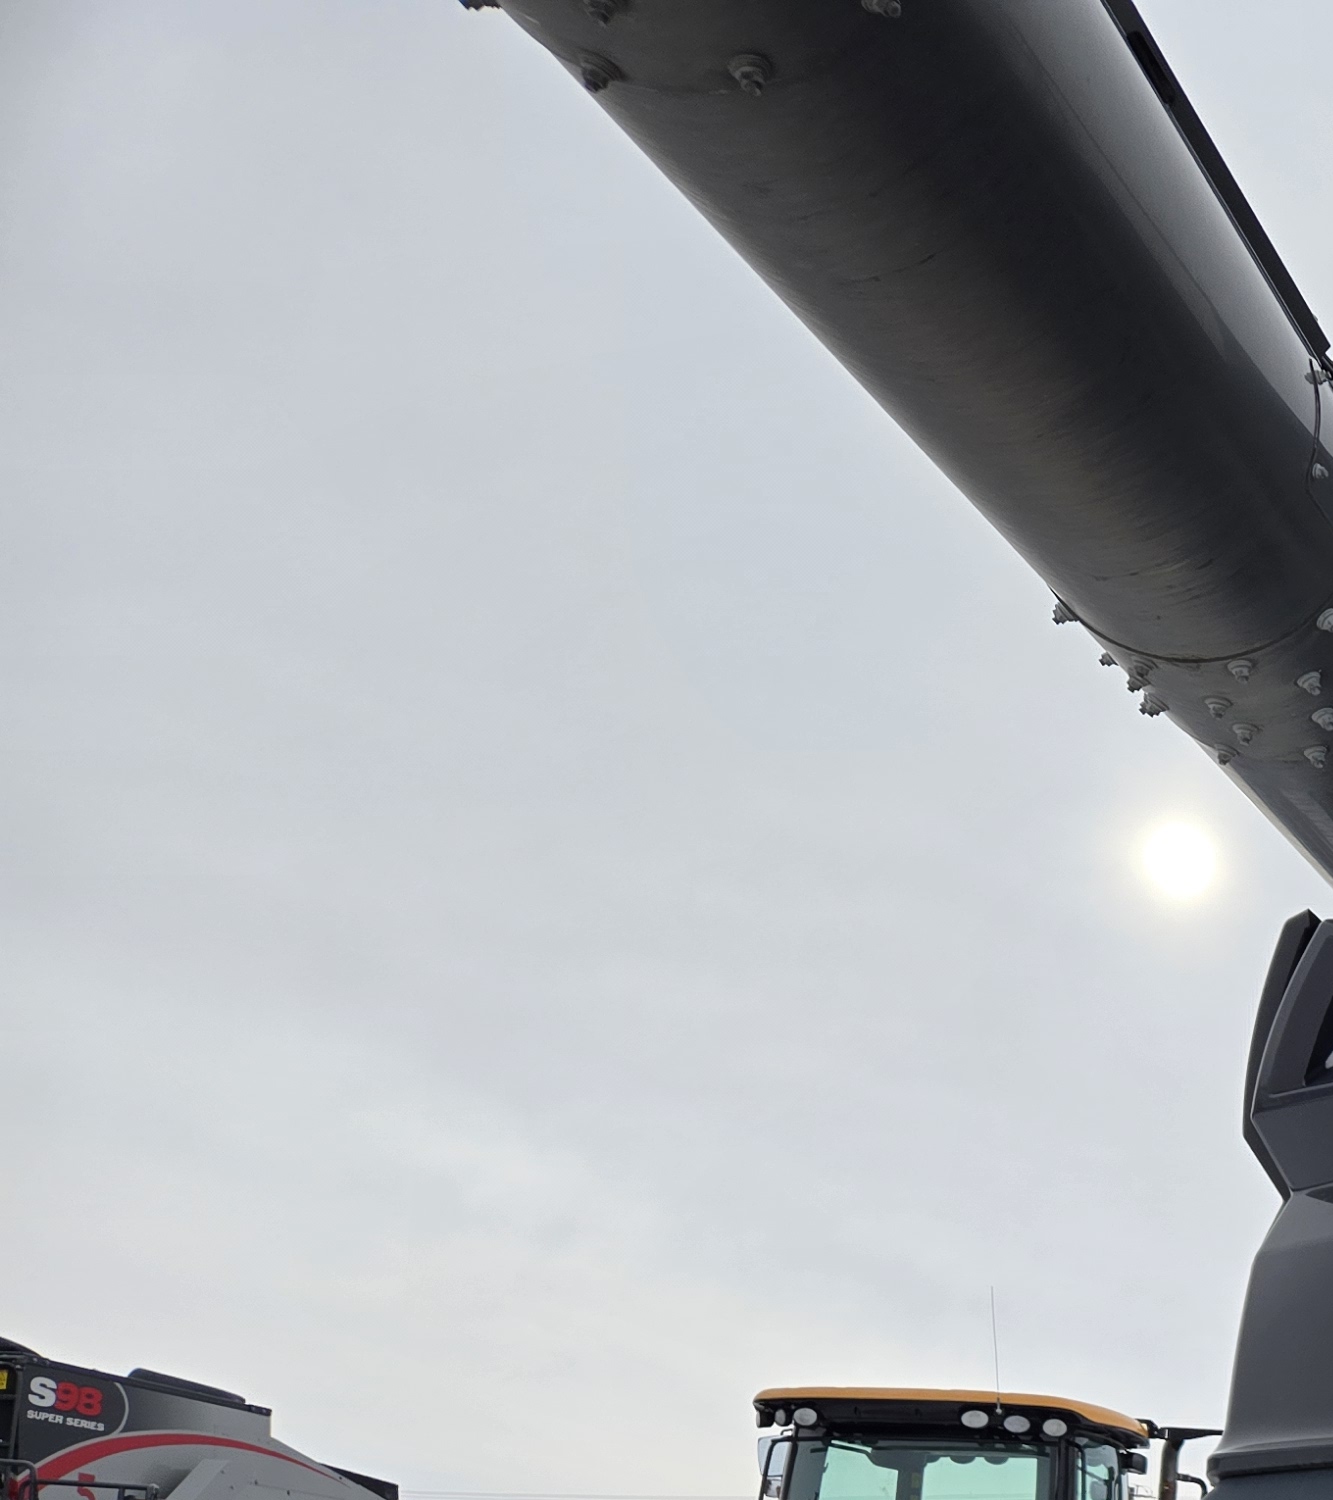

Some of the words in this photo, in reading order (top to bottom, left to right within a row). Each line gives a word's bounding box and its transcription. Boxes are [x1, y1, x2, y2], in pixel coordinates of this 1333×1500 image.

[28, 1376, 104, 1417] S98
[27, 1410, 63, 1424] SUPER
[66, 1417, 105, 1431] SERIES
